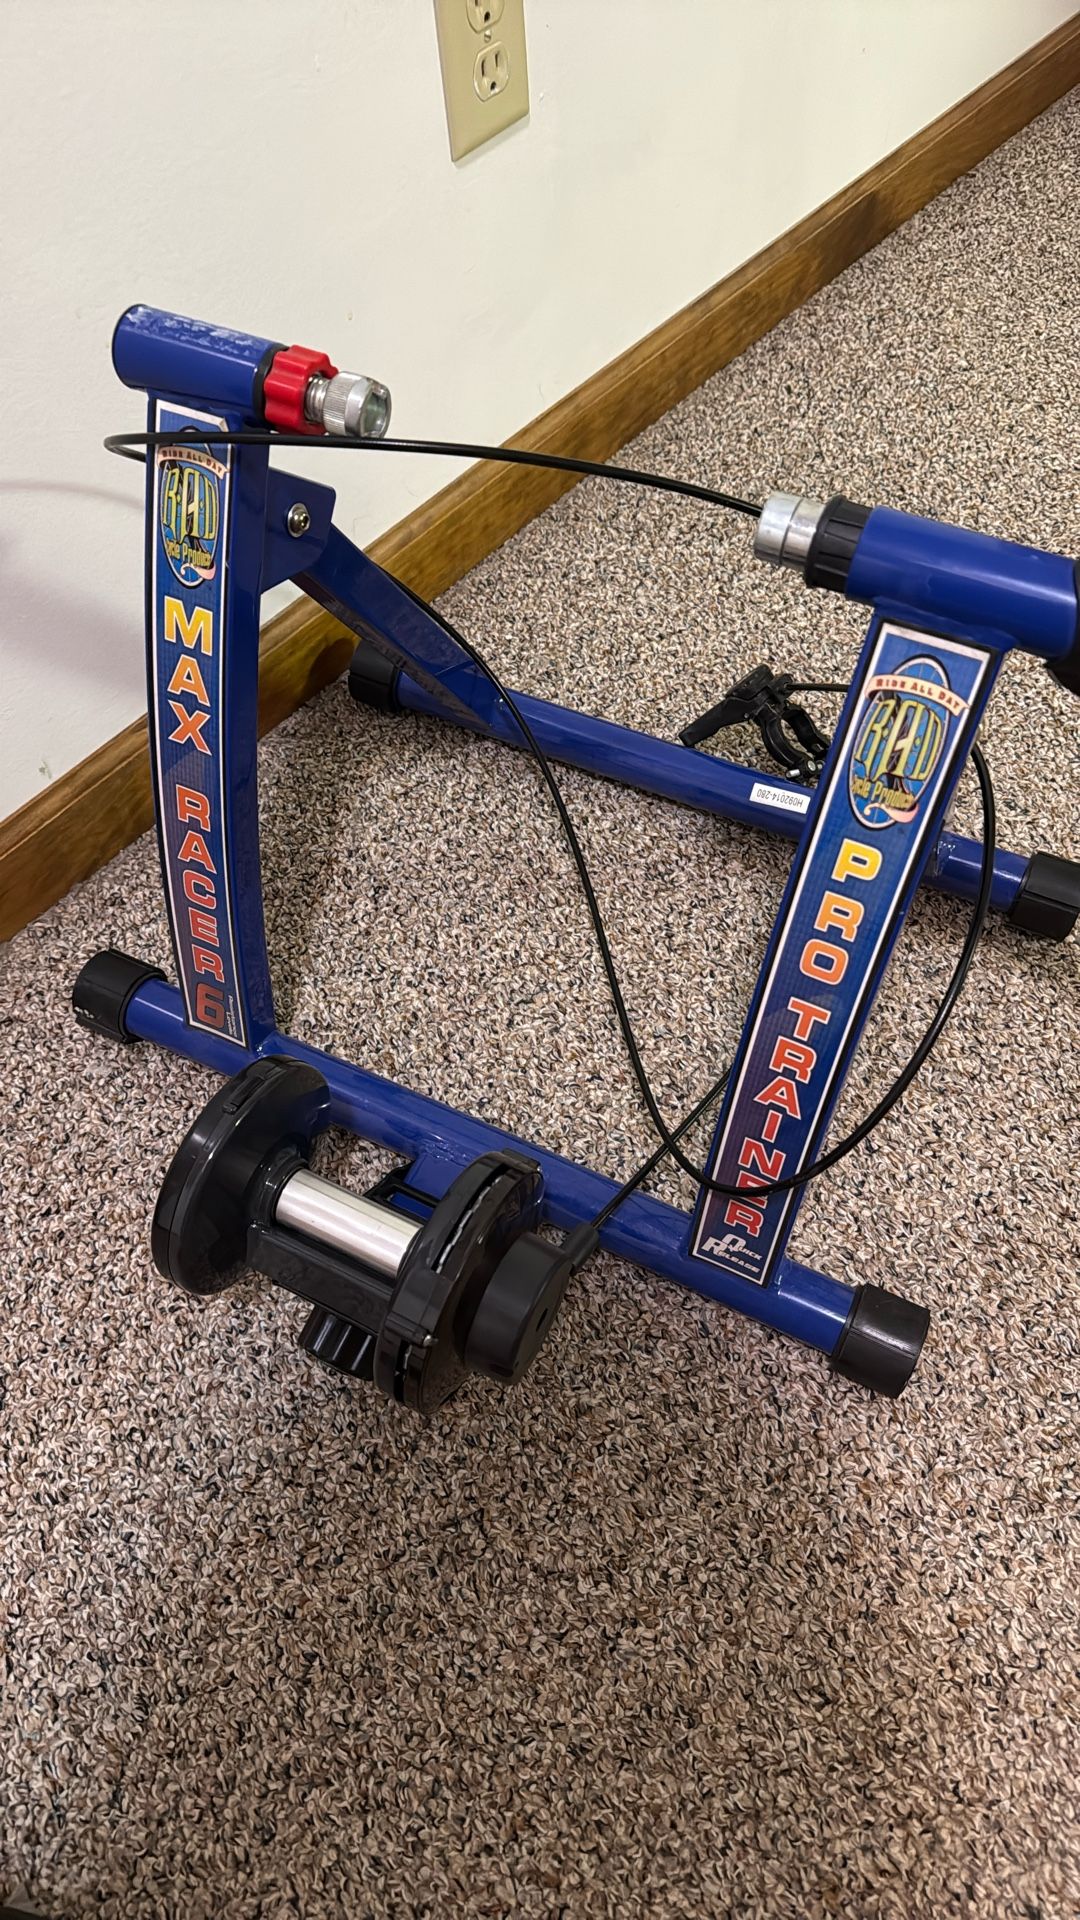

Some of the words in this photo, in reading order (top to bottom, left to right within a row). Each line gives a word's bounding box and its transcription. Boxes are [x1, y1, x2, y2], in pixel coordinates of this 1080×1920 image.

[164, 595, 213, 756] MAX
[910, 682, 934, 697] ALL
[937, 690, 961, 710] DAY
[175, 783, 225, 983] RACER
[798, 838, 883, 986] PRO
[195, 982, 225, 1029] 6
